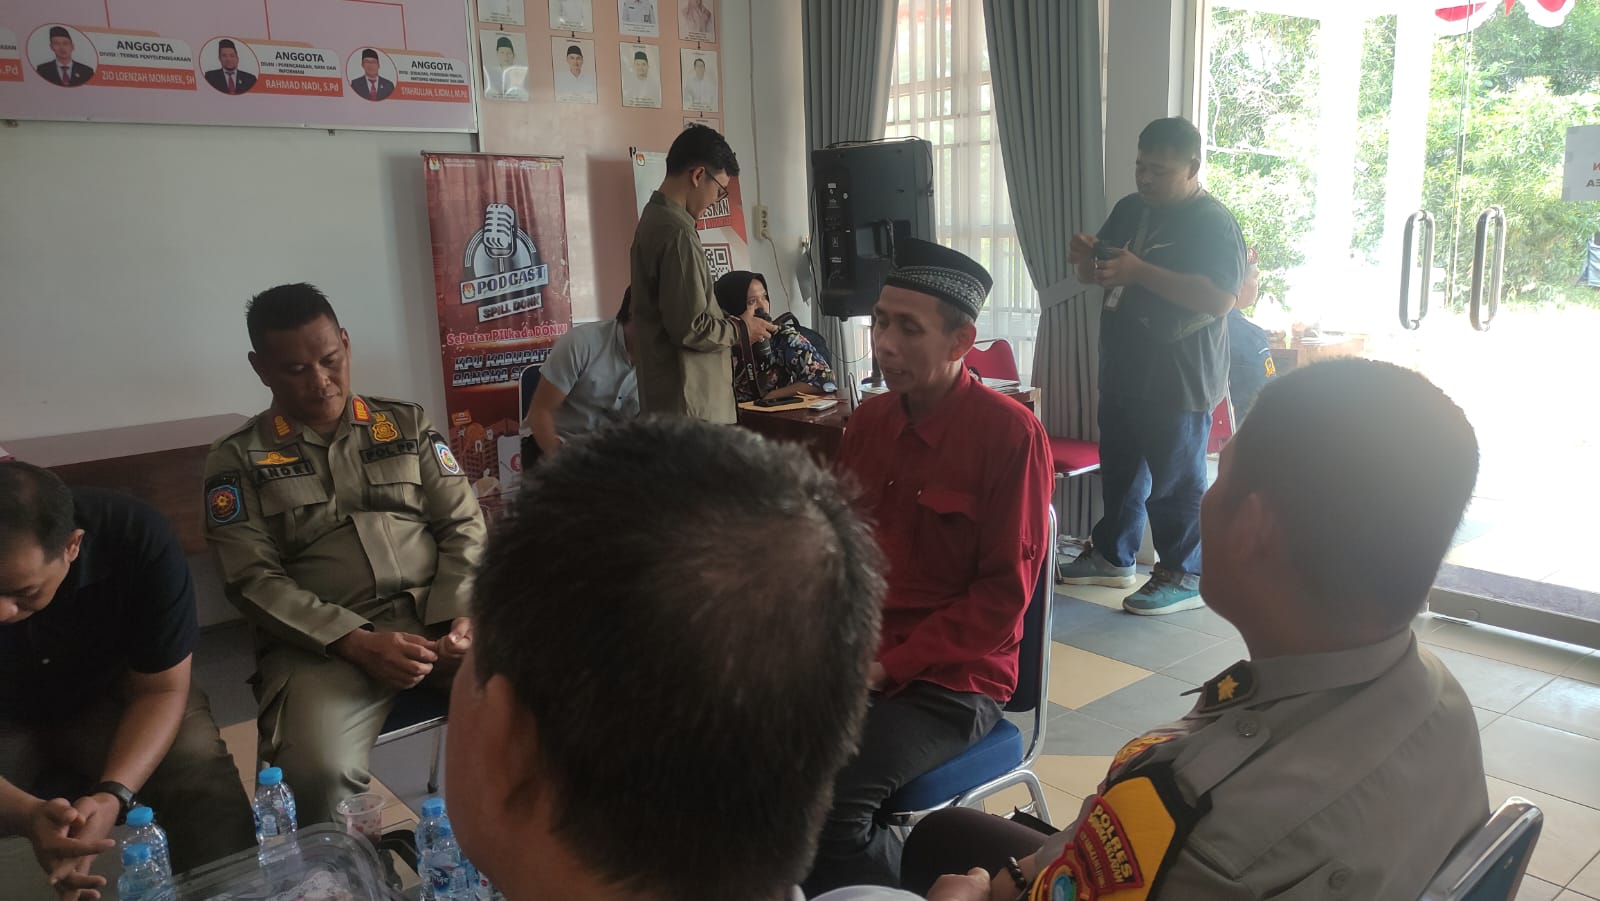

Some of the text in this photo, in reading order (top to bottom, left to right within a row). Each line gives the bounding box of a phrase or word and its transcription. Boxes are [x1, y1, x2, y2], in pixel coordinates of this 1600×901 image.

[116, 41, 174, 53] ANGGOTA
[275, 51, 324, 63] ANGGOTA
[411, 60, 453, 71] ANGGOTA
[477, 266, 545, 295] PODCAST
[482, 303, 512, 319] SPILL
[454, 354, 484, 371] KPU
[452, 367, 509, 387] BANGKA
[1094, 804, 1133, 879] POLRES
